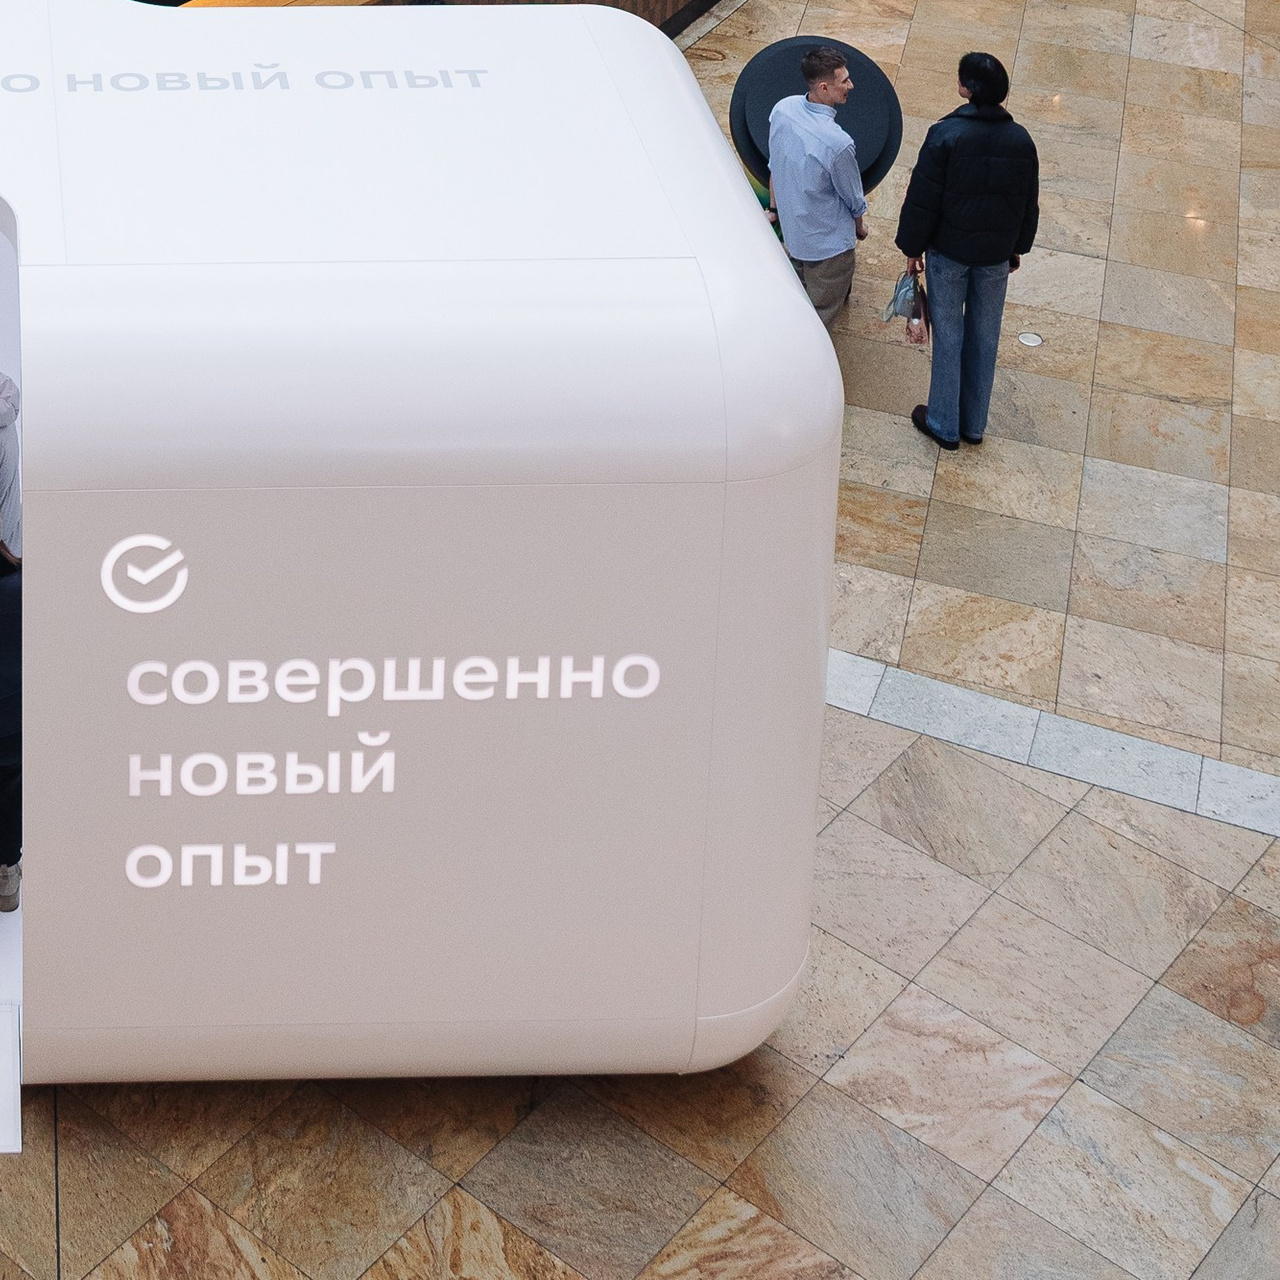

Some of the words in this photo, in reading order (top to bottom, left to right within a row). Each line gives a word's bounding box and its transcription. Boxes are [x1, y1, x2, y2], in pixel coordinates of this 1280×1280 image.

[65, 62, 290, 93] новый
[314, 67, 489, 92] опыт
[125, 652, 662, 718] совершенно
[126, 730, 398, 798] новый
[124, 841, 337, 889] опыт
